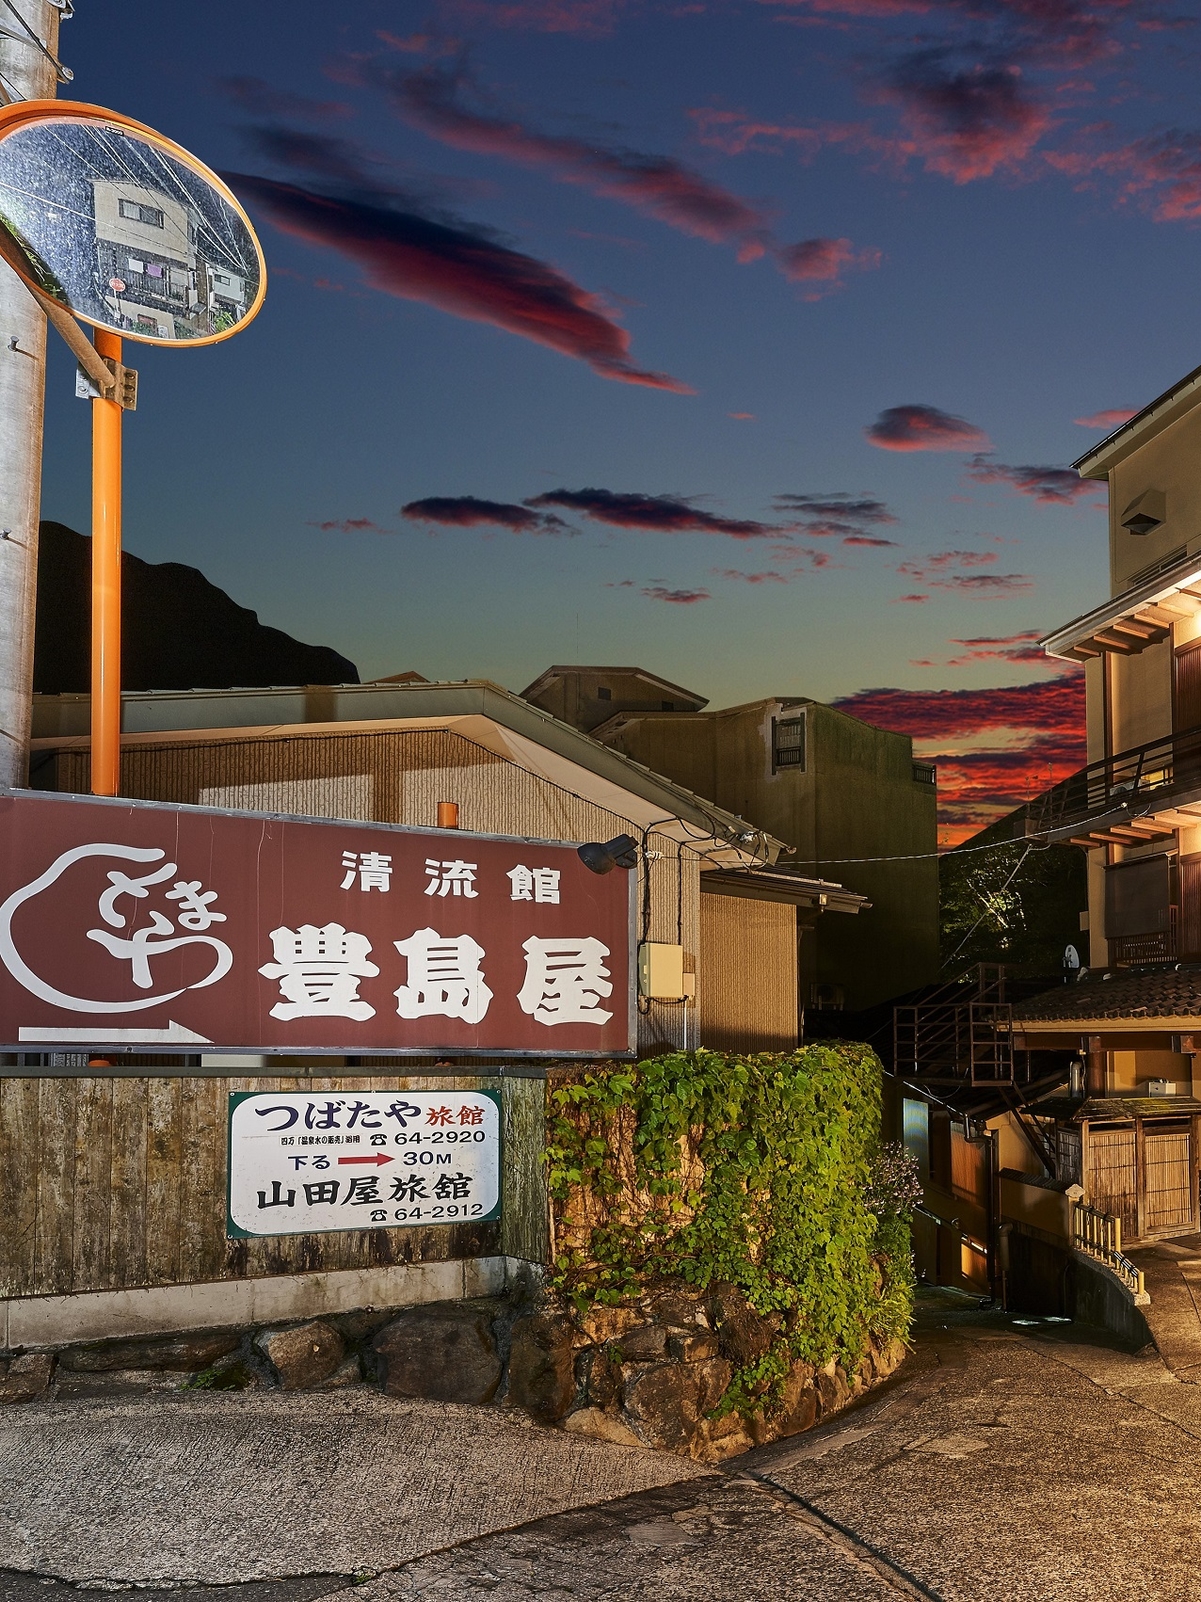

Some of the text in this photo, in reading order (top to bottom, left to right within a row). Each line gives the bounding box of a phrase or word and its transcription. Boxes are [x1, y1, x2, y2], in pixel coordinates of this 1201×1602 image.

[340, 850, 562, 905] 清流館
[258, 922, 614, 1026] 豊島屋
[255, 1099, 486, 1131] つばたや旅館
[394, 1131, 485, 1145] 64-2920
[288, 1155, 331, 1170] 下る
[394, 1204, 483, 1221] 64-2912
